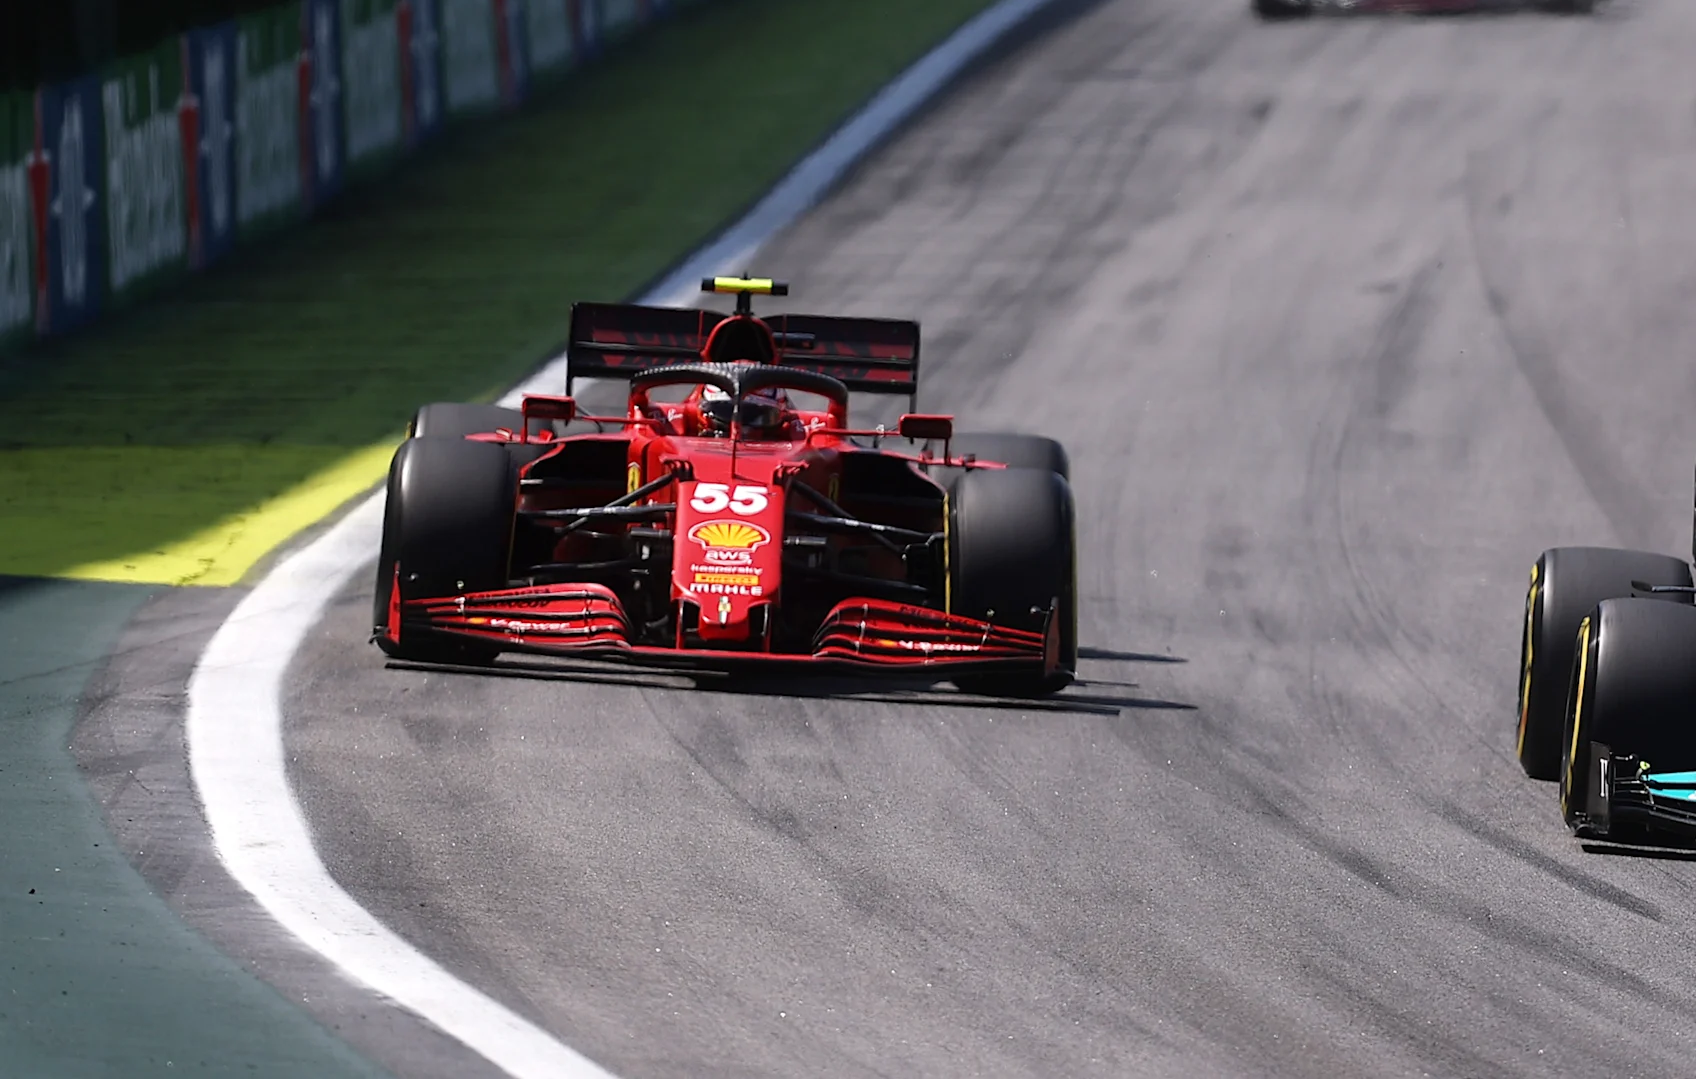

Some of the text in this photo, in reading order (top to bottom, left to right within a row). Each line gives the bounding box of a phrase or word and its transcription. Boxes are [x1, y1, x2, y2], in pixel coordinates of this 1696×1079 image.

[690, 482, 768, 515] 55
[704, 550, 752, 564] aws
[691, 564, 762, 575] kaspersky
[690, 583, 762, 595] MAHLE
